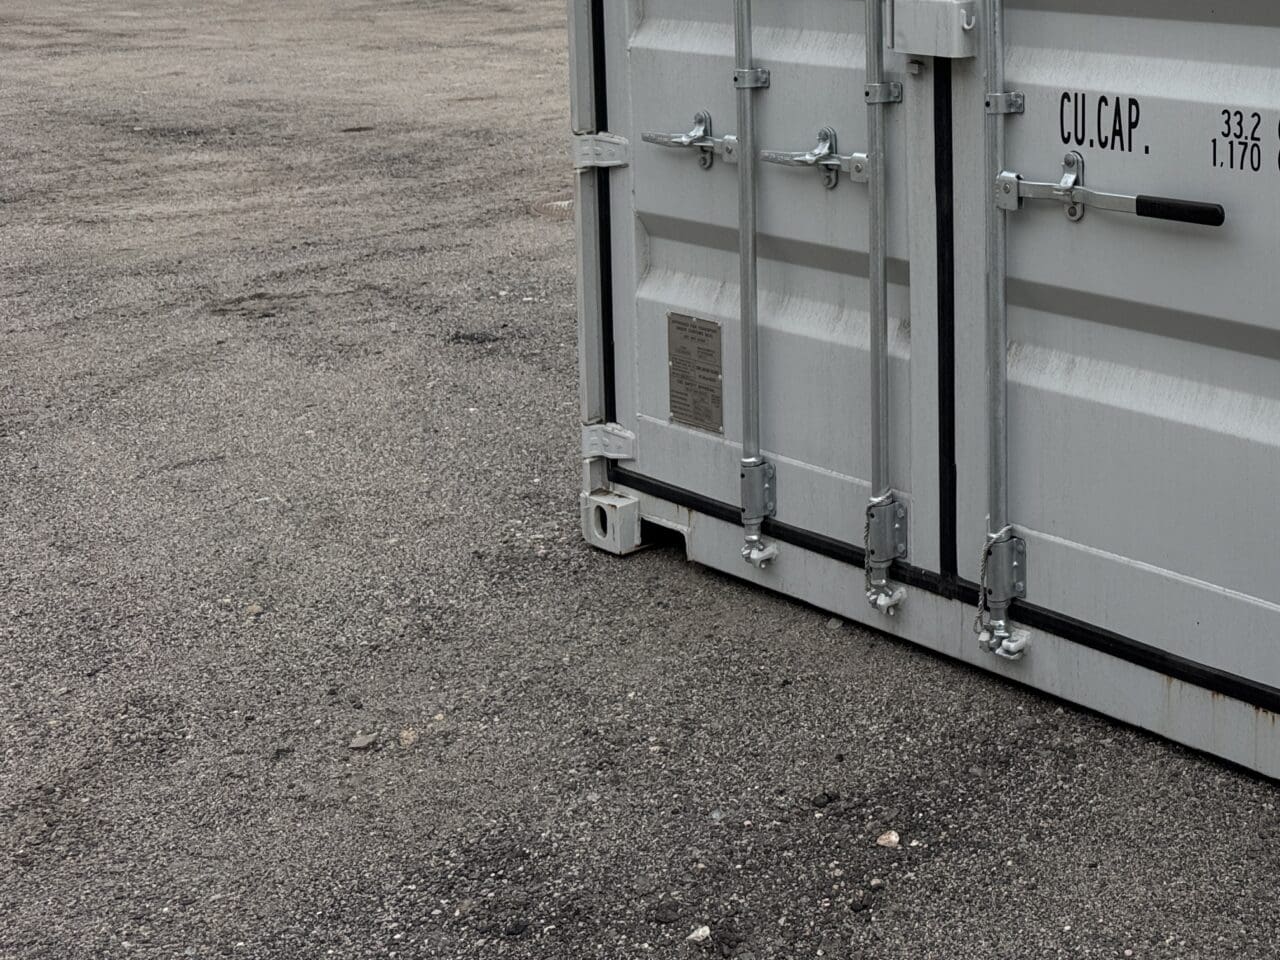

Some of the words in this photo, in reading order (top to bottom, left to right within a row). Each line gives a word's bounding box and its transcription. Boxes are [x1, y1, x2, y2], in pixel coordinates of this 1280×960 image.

[1060, 92, 1150, 155] CU.CAP.
[1221, 109, 1262, 142] 33.2
[1211, 138, 1261, 172] 1,170
